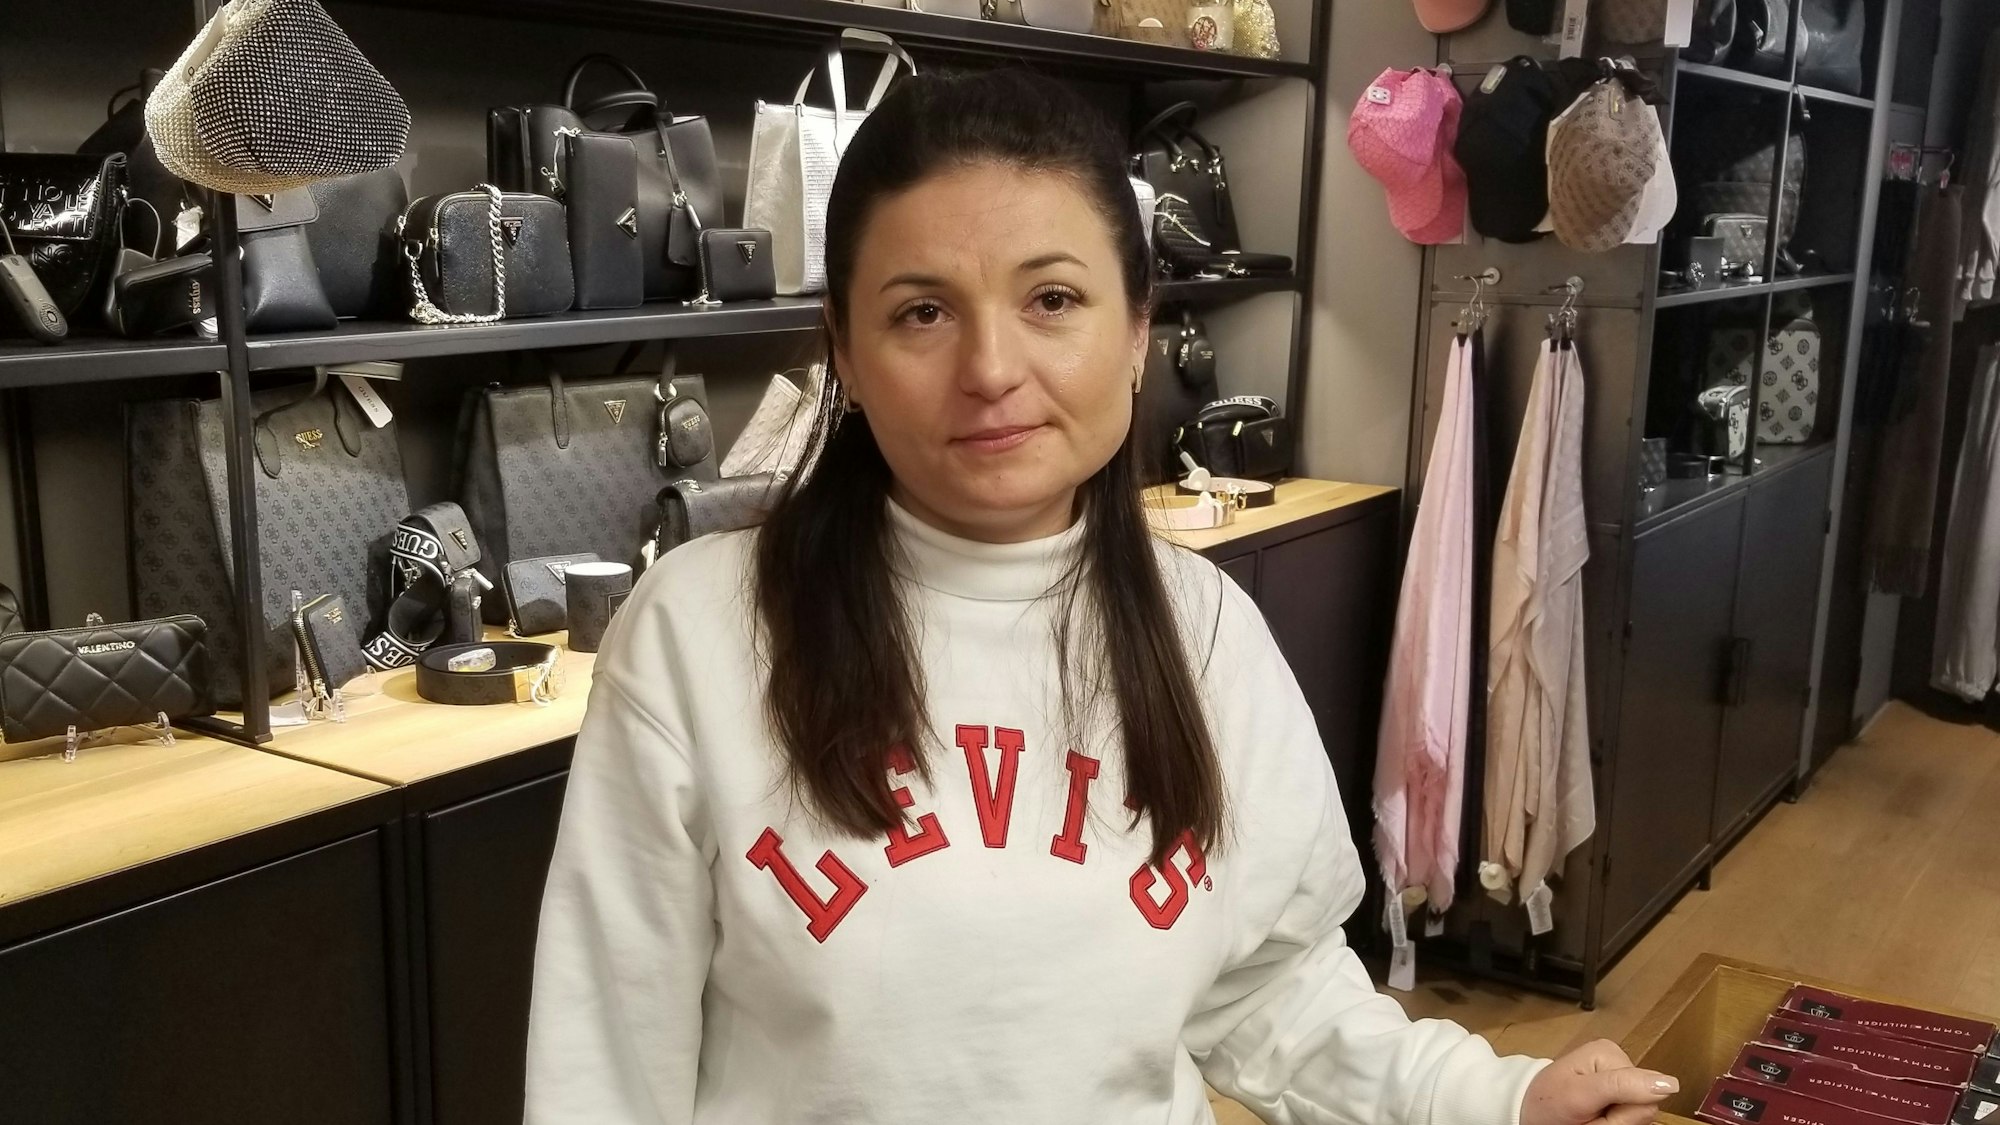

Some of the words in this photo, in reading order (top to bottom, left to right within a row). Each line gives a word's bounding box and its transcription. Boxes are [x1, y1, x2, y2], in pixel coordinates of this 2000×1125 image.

[392, 529, 439, 559] GUES
[77, 641, 136, 654] VALENTINO
[746, 724, 1207, 943] LEVIS
[1857, 1020, 1908, 1029] HILFIGER
[1924, 1026, 1971, 1036] TOMMY
[1833, 1045, 1886, 1059] HILFIGER
[1903, 1059, 1951, 1072] TOMMY
[1809, 1078, 1863, 1093] HILFIGER
[1880, 1094, 1931, 1108] TOMMY
